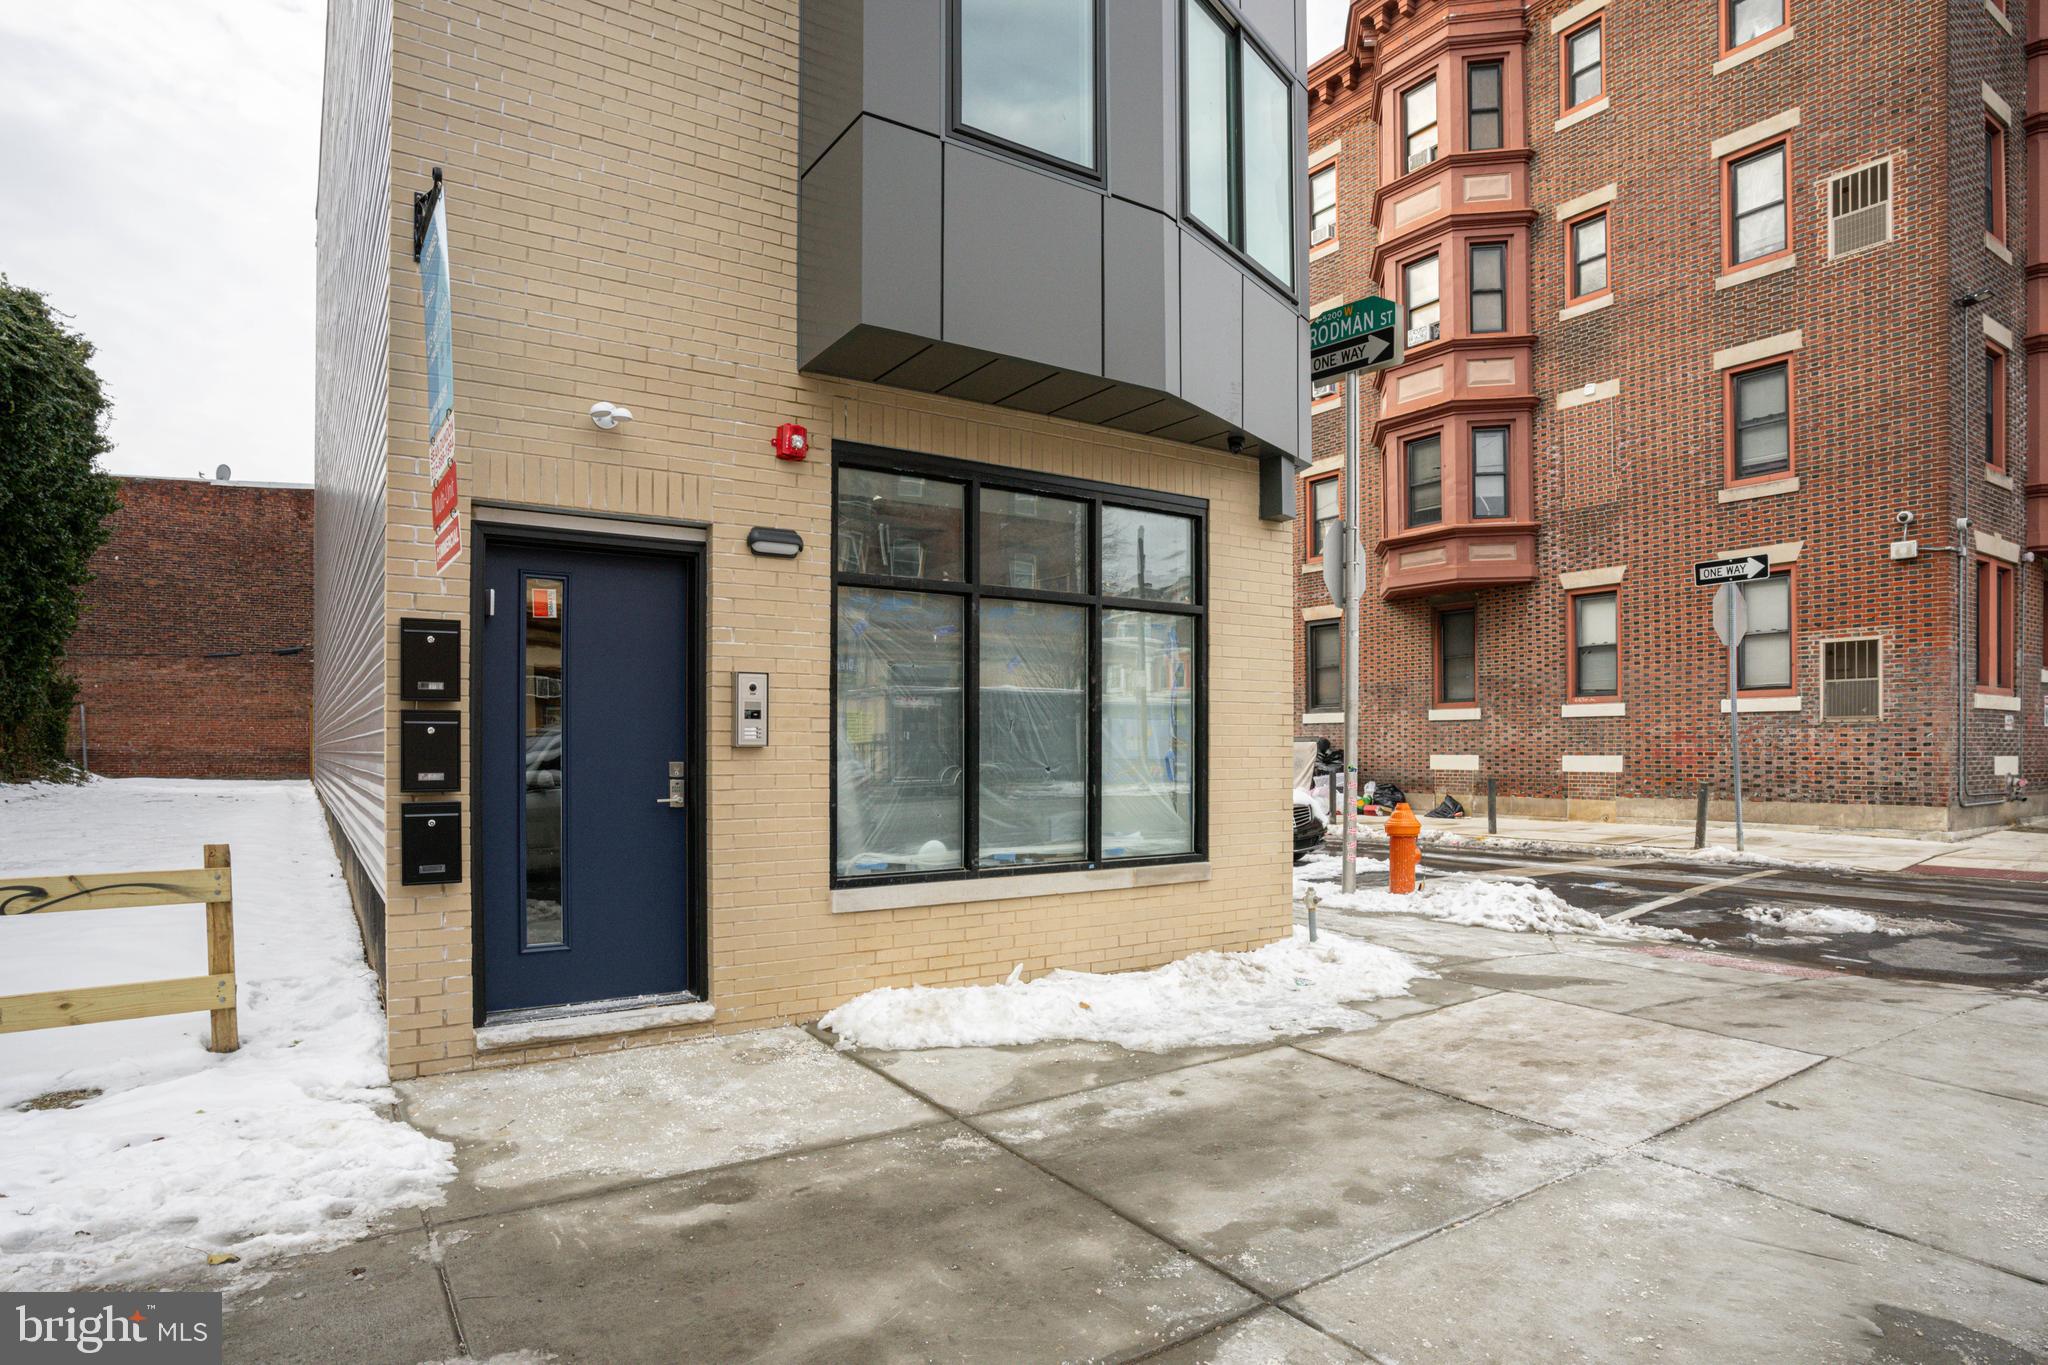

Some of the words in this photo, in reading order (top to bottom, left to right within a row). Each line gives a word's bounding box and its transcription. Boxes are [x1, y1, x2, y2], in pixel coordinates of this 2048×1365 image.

[1322, 310, 1343, 323] 5200
[1311, 309, 1374, 346] RODMAN
[1380, 310, 1393, 326] ST
[1313, 353, 1337, 371] ONE
[1341, 345, 1366, 363] WAY
[1703, 567, 1723, 579] ONE
[1726, 563, 1747, 576] WAY
